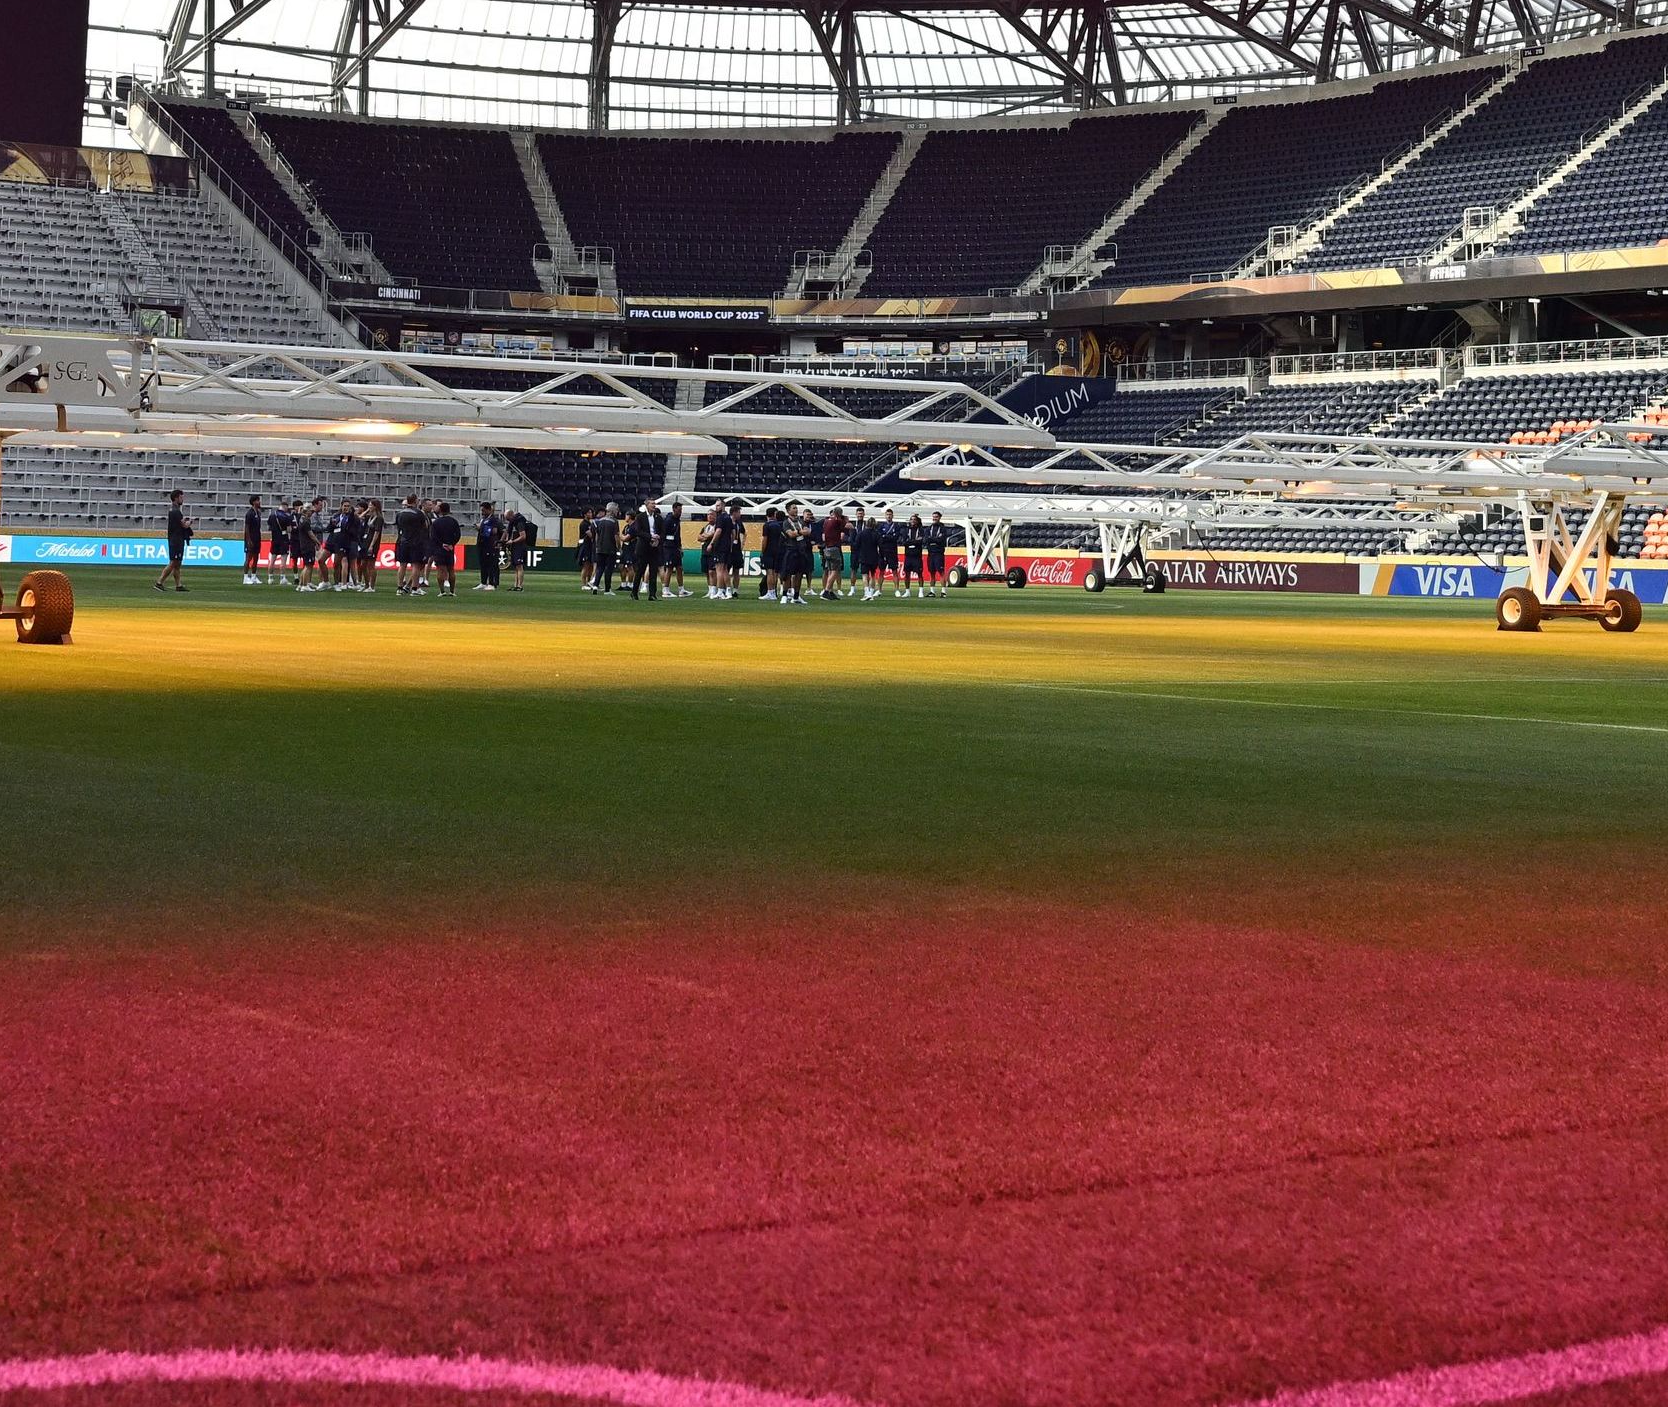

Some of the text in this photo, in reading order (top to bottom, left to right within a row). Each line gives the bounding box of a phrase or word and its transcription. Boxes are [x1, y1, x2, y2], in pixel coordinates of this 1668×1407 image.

[378, 286, 421, 300] CINCINNATI
[629, 309, 650, 319] FIFA
[652, 310, 676, 319] CLUB
[678, 310, 713, 320] WORLD
[714, 311, 734, 320] CUP
[54, 361, 93, 380] SGL
[35, 542, 223, 560] Michelob ULTRA ERO
[1027, 558, 1076, 584] Coca-Cola
[1215, 562, 1298, 586] AIRWAYS
[1412, 566, 1475, 597] VISA
